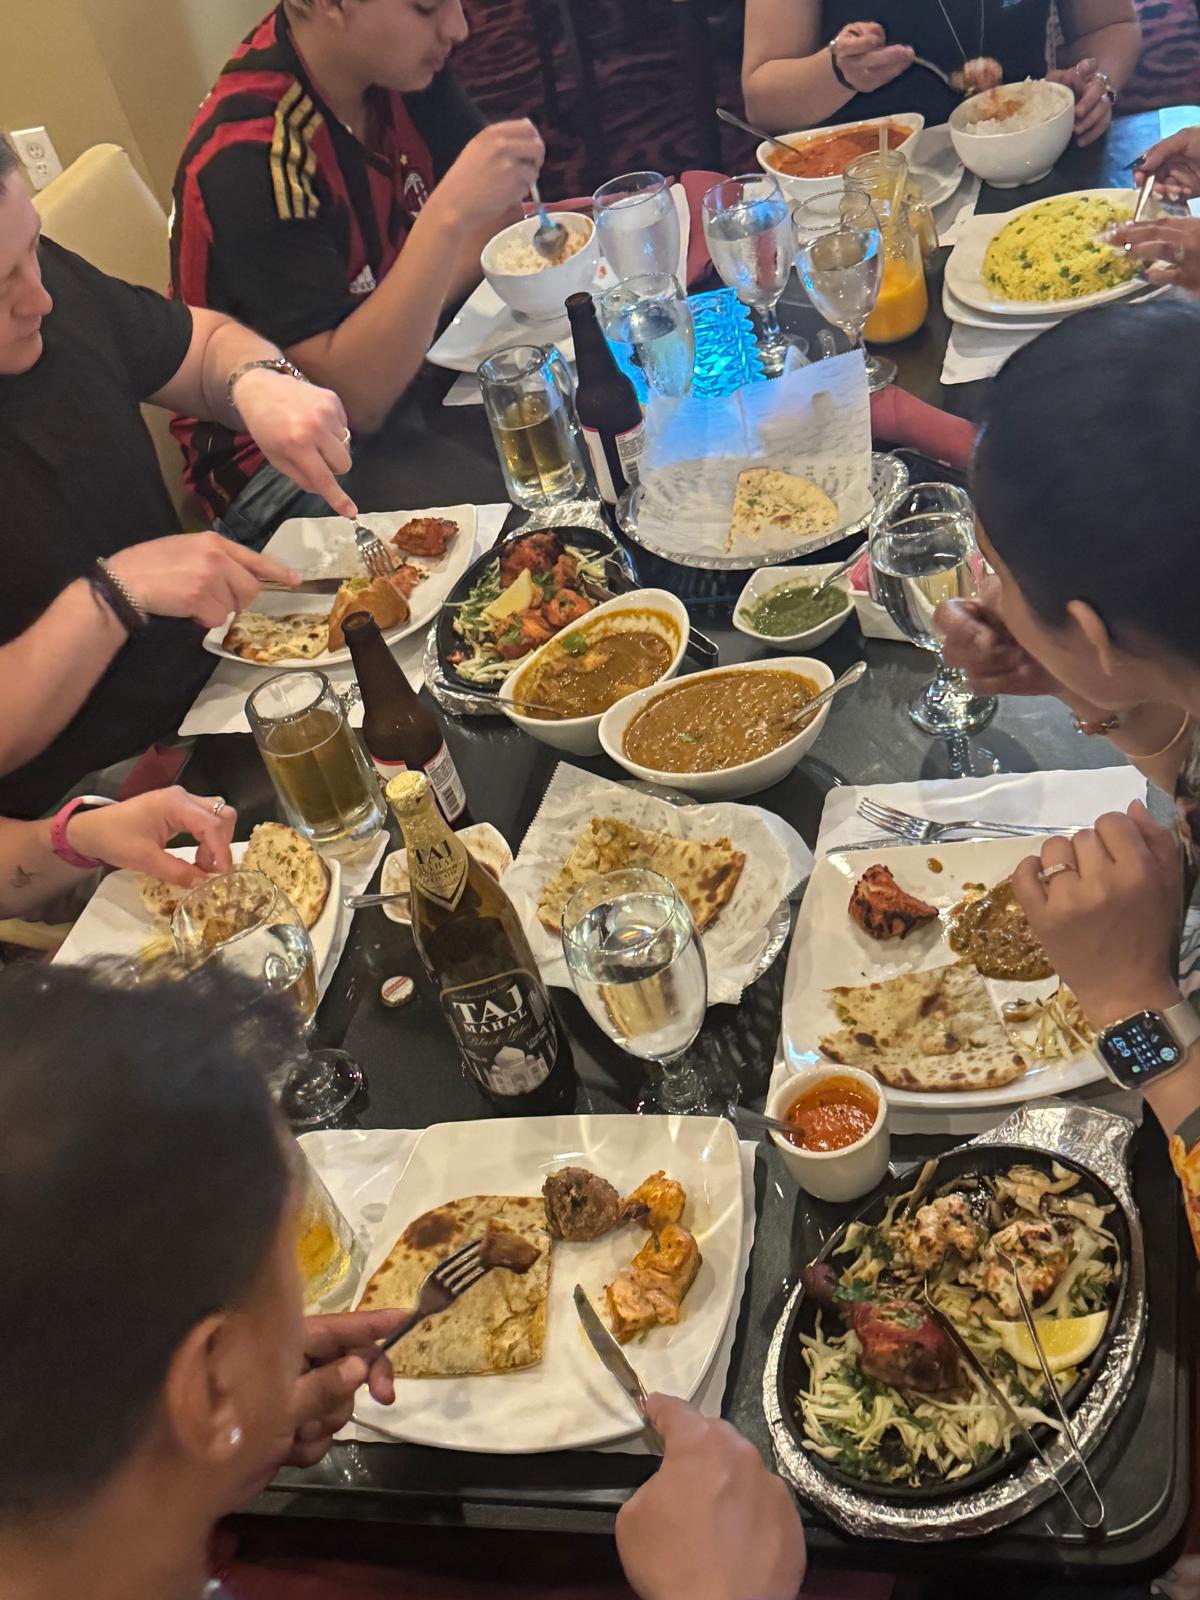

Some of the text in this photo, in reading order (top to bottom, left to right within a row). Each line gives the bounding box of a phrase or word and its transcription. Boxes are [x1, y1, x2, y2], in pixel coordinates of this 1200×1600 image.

[411, 840, 452, 864] TAJ
[452, 984, 523, 1024] TAJ
[463, 1009, 527, 1033] MAHAL
